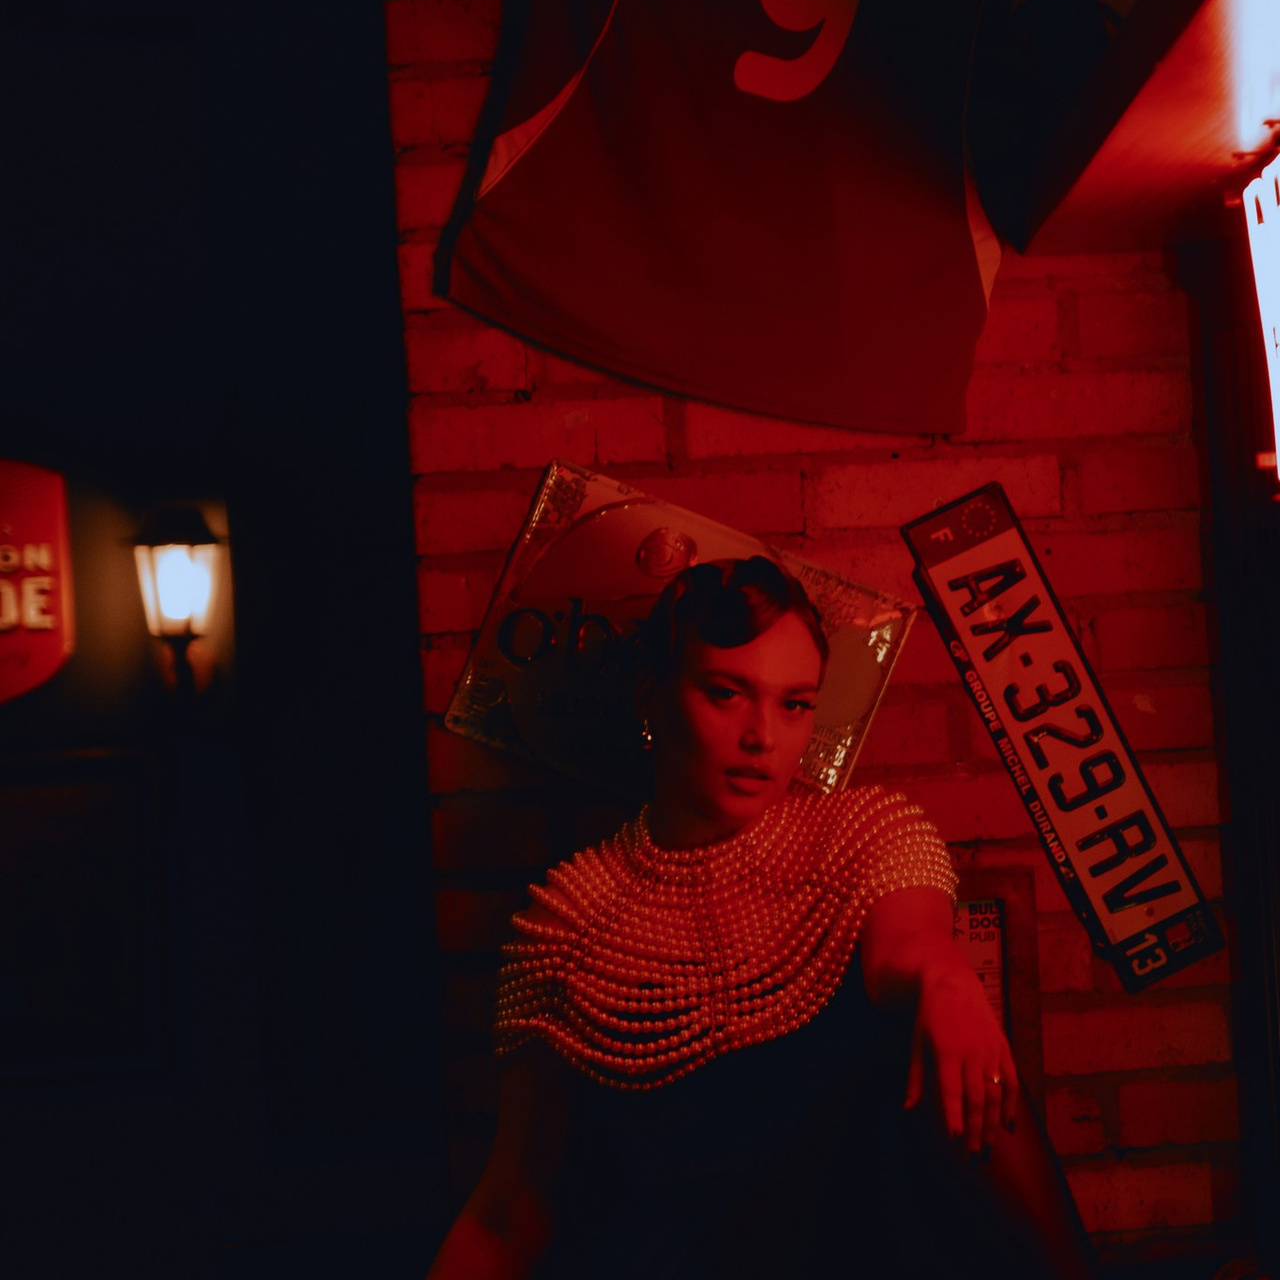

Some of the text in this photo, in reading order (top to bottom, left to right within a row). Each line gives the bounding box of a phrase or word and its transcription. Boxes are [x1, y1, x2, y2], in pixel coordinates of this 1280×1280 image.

[946, 548, 1182, 924] AX-329-RV
[962, 669, 1002, 733] GROUPE
[995, 736, 1033, 797] MICHEL
[1027, 799, 1066, 864] DURAND
[1120, 930, 1170, 980] 13
